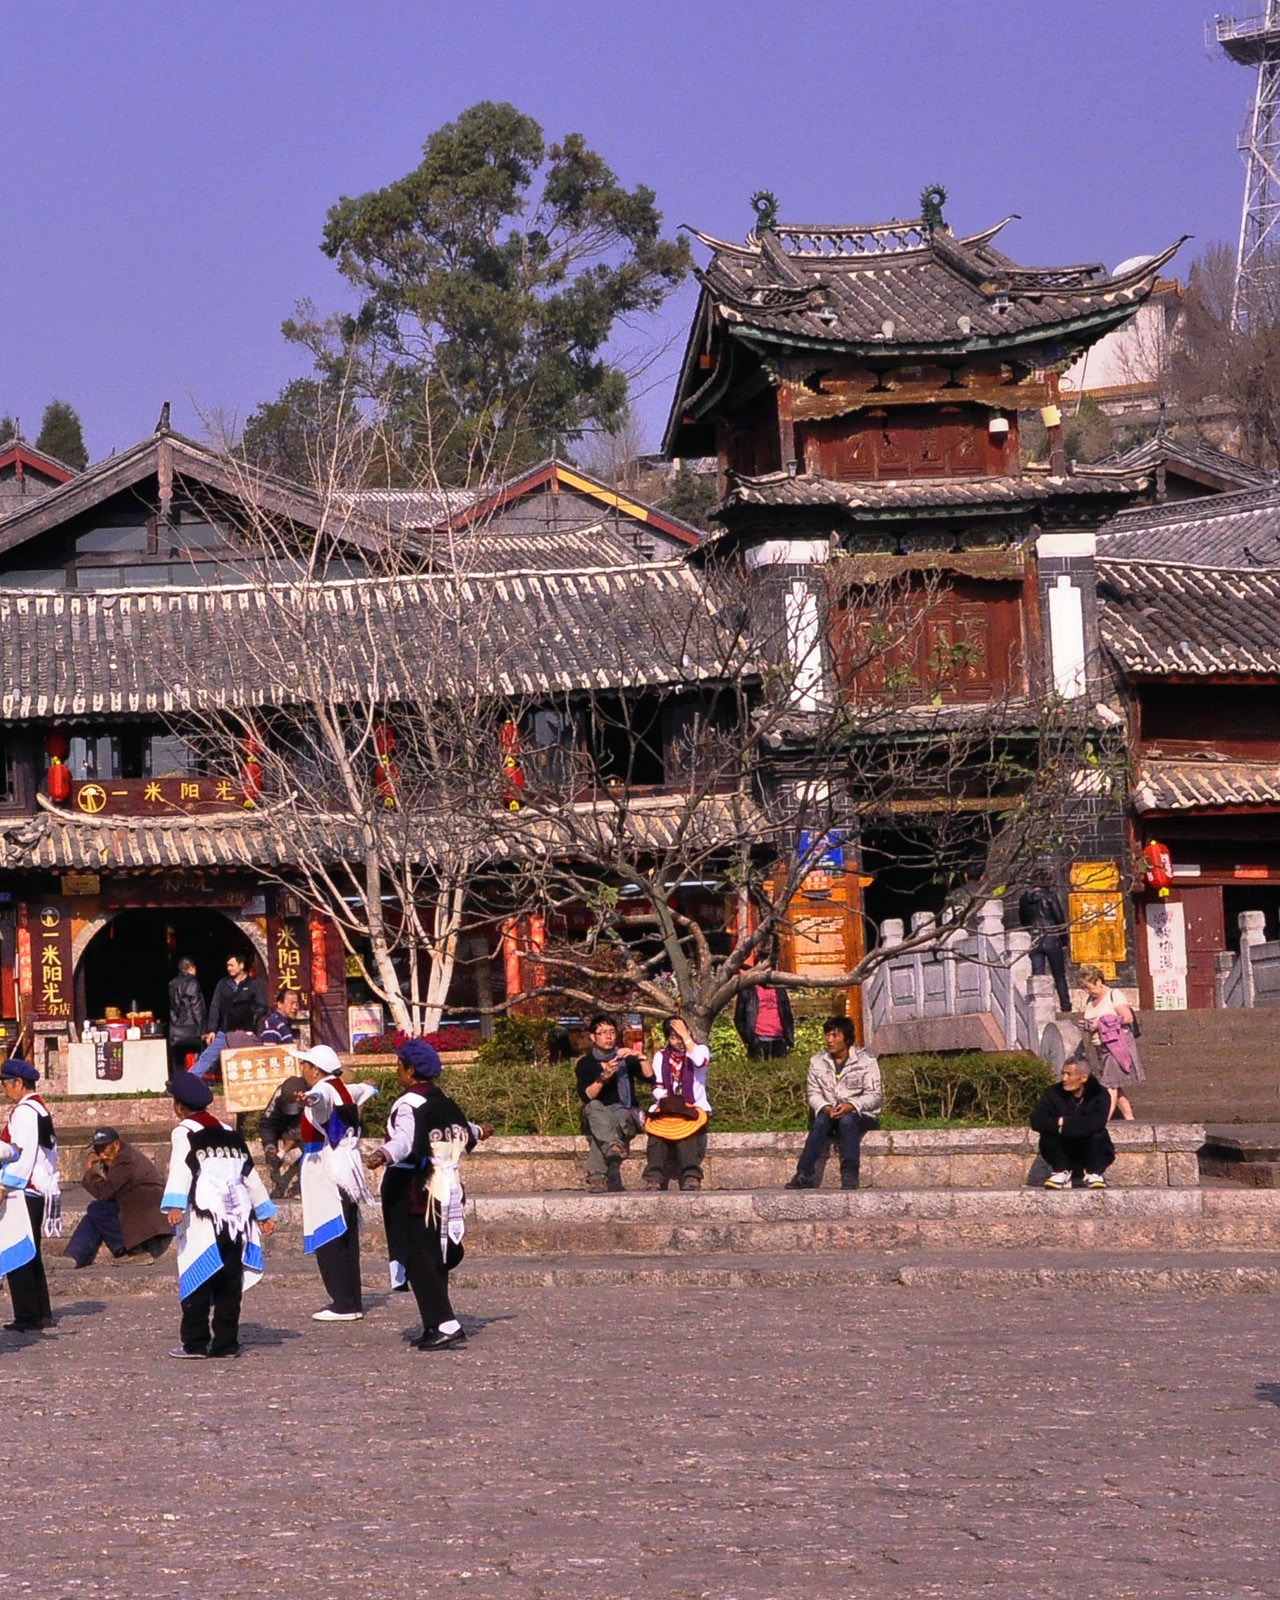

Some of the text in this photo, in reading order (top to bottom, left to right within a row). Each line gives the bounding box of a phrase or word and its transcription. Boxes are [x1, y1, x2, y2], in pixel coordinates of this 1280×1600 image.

[111, 780, 236, 802] 一米阳光
[41, 931, 64, 1004] 一米阳光
[36, 1003, 71, 1016] 三分店
